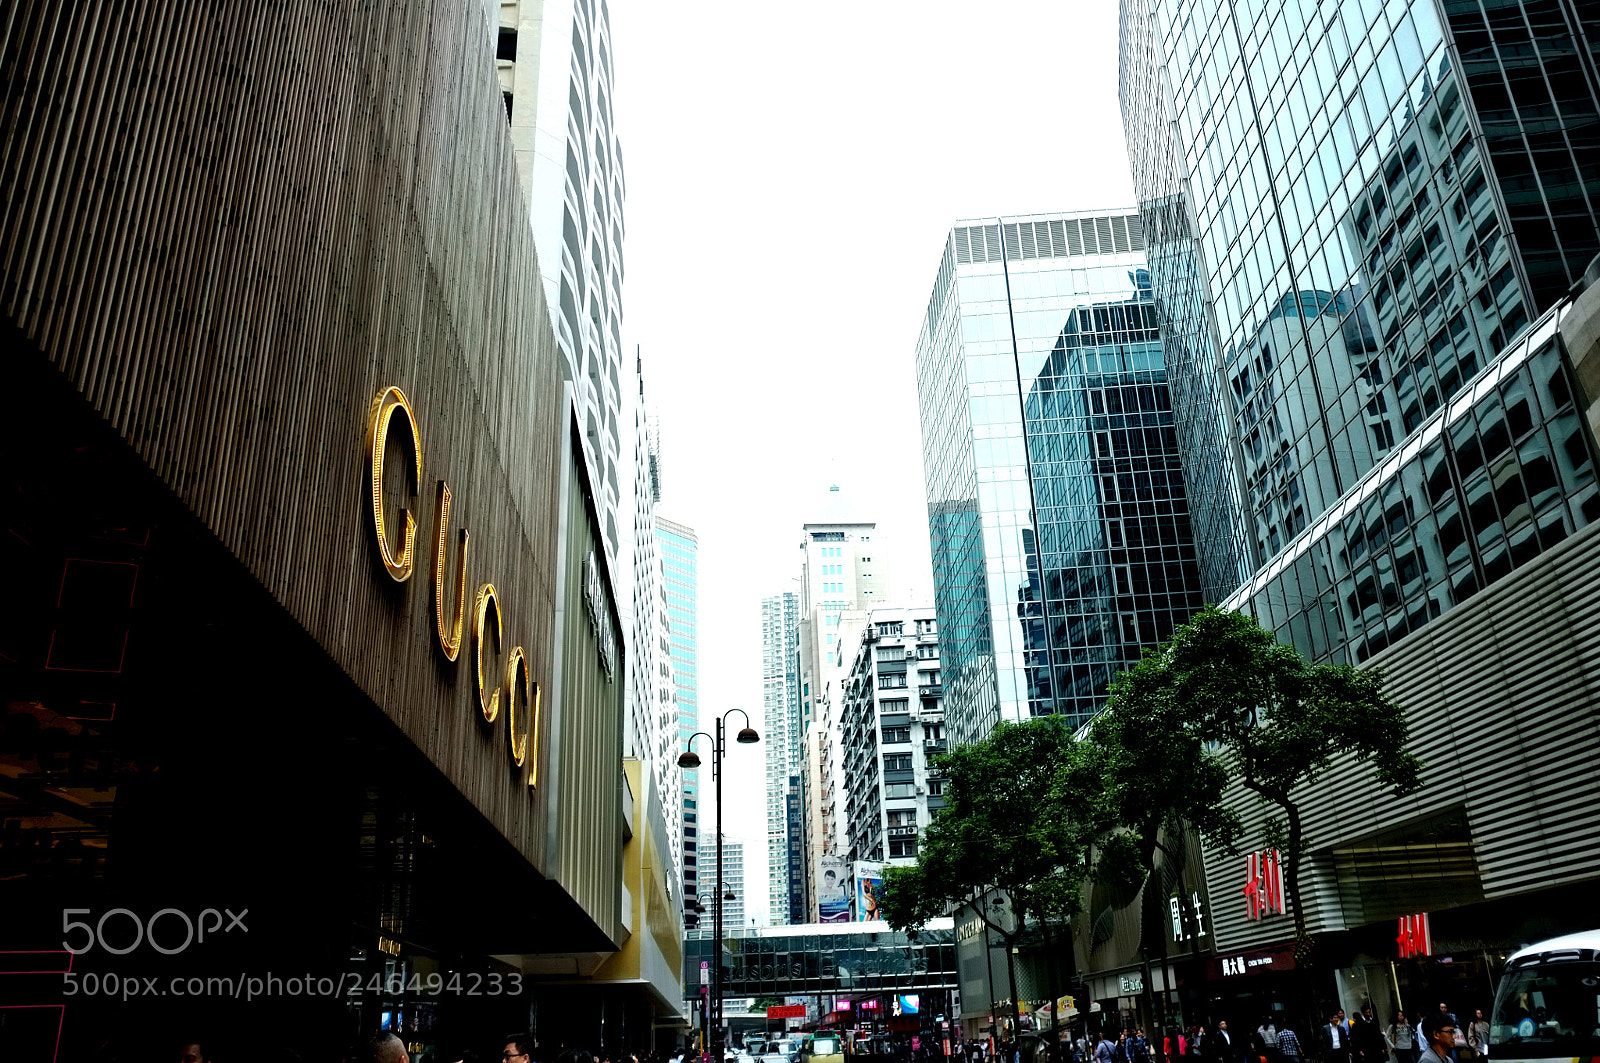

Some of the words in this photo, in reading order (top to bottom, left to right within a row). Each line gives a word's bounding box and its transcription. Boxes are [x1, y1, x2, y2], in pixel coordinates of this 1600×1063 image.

[366, 385, 541, 790] GUCCI
[1243, 849, 1286, 920] H&M
[1170, 891, 1206, 942] 周生
[1396, 912, 1432, 959] H&M
[1222, 956, 1246, 977] 周大福
